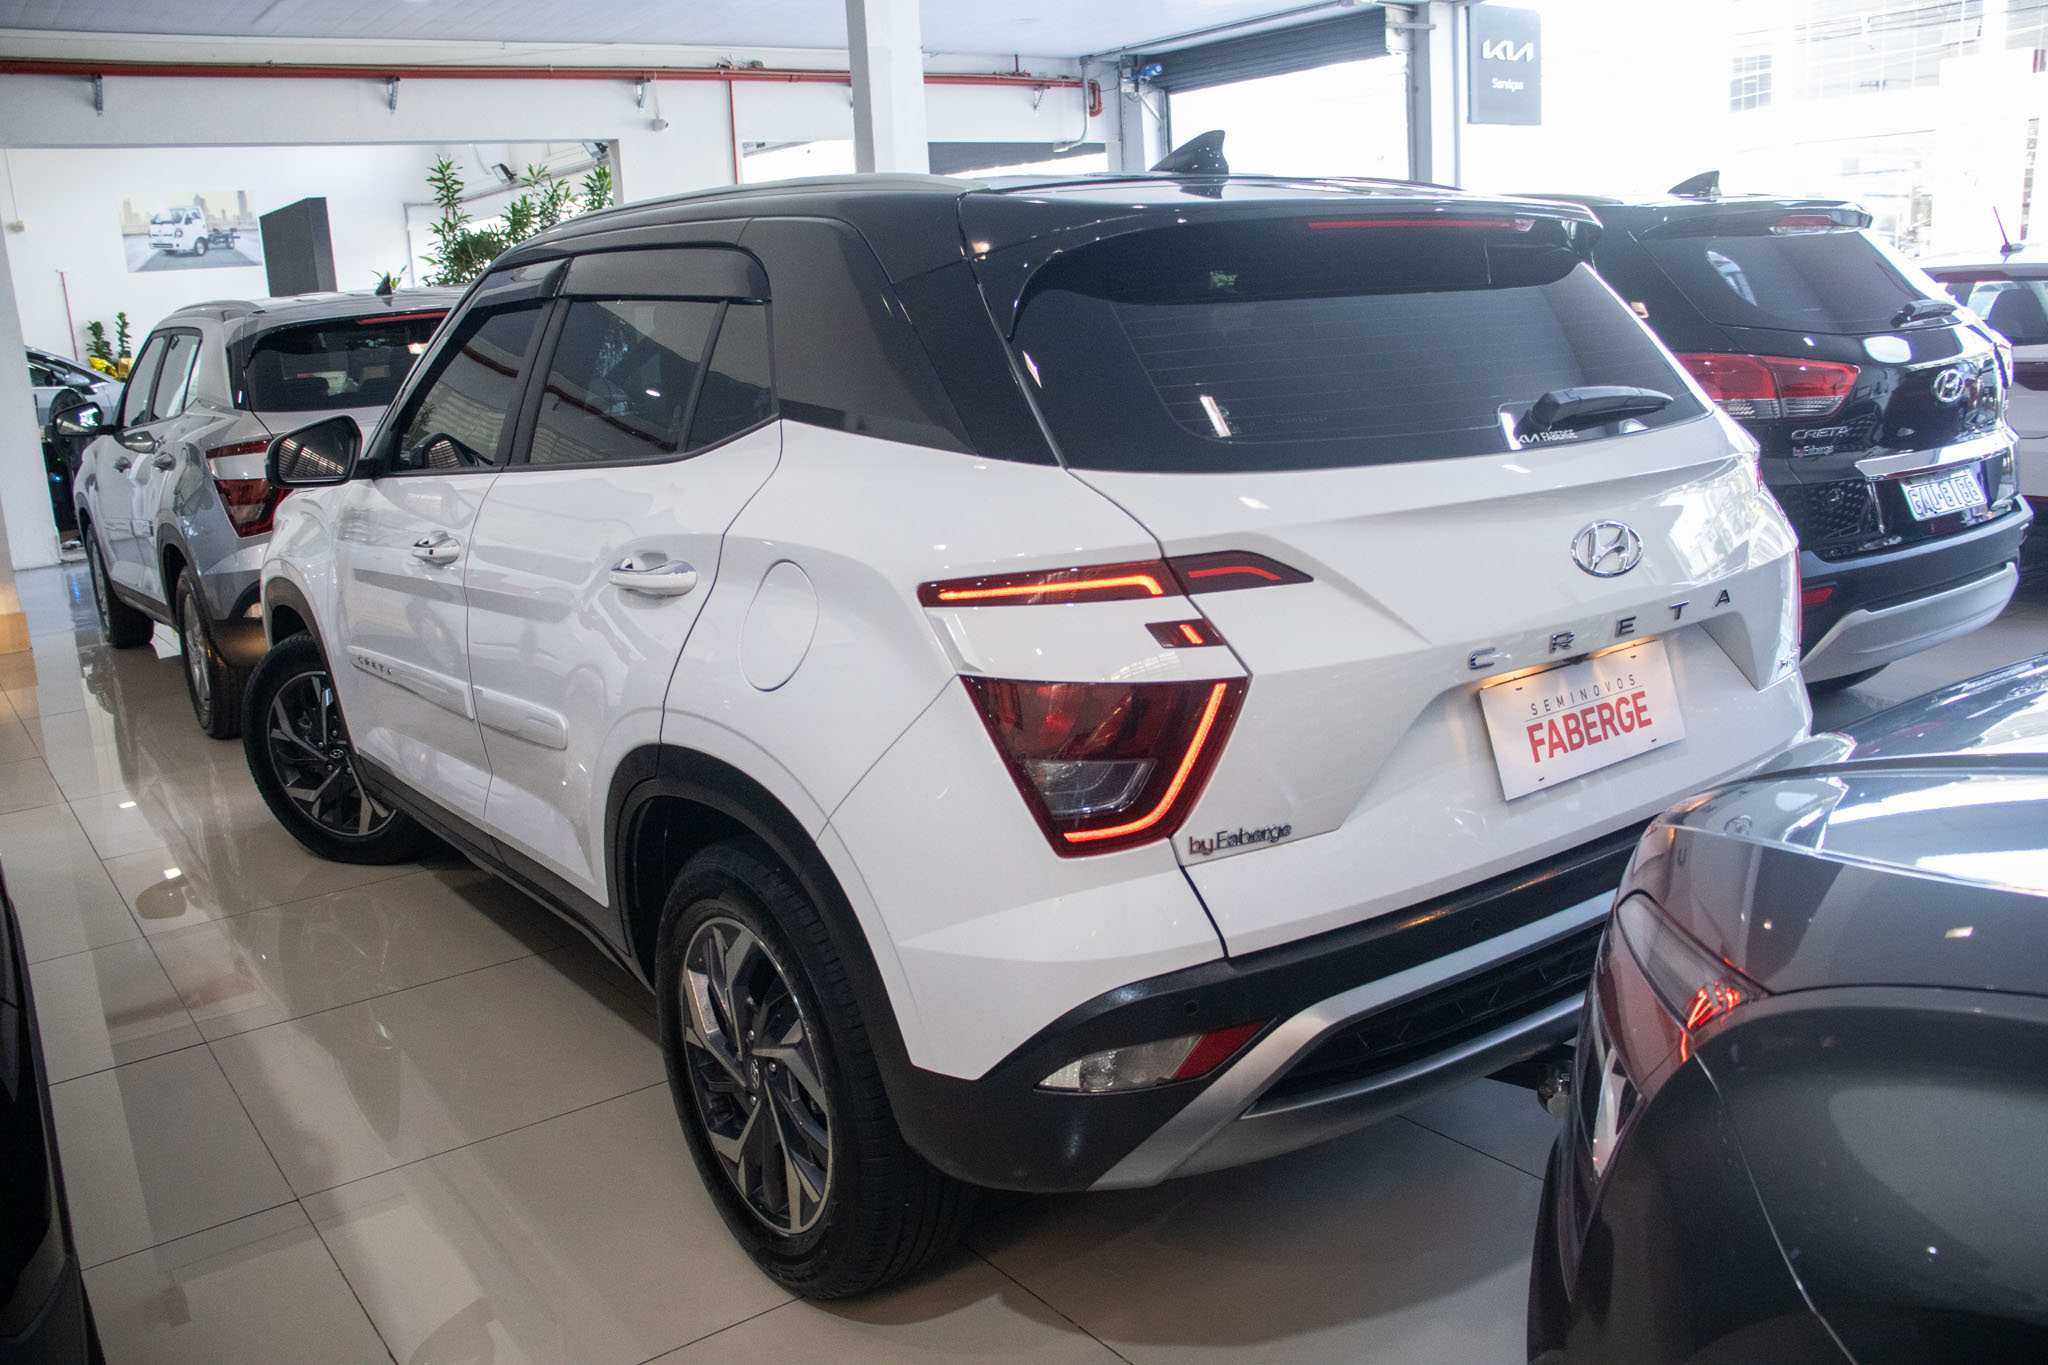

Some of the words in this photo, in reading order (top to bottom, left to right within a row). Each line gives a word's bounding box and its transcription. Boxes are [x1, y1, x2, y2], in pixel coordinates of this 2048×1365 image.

[1482, 39, 1534, 63] KIA
[1539, 429, 1579, 442] FABERGE
[1791, 425, 1849, 440] CRETA
[1468, 588, 1732, 671] CRETA
[1530, 674, 1636, 716] SEMINOVOS
[1526, 690, 1653, 764] FABERGE
